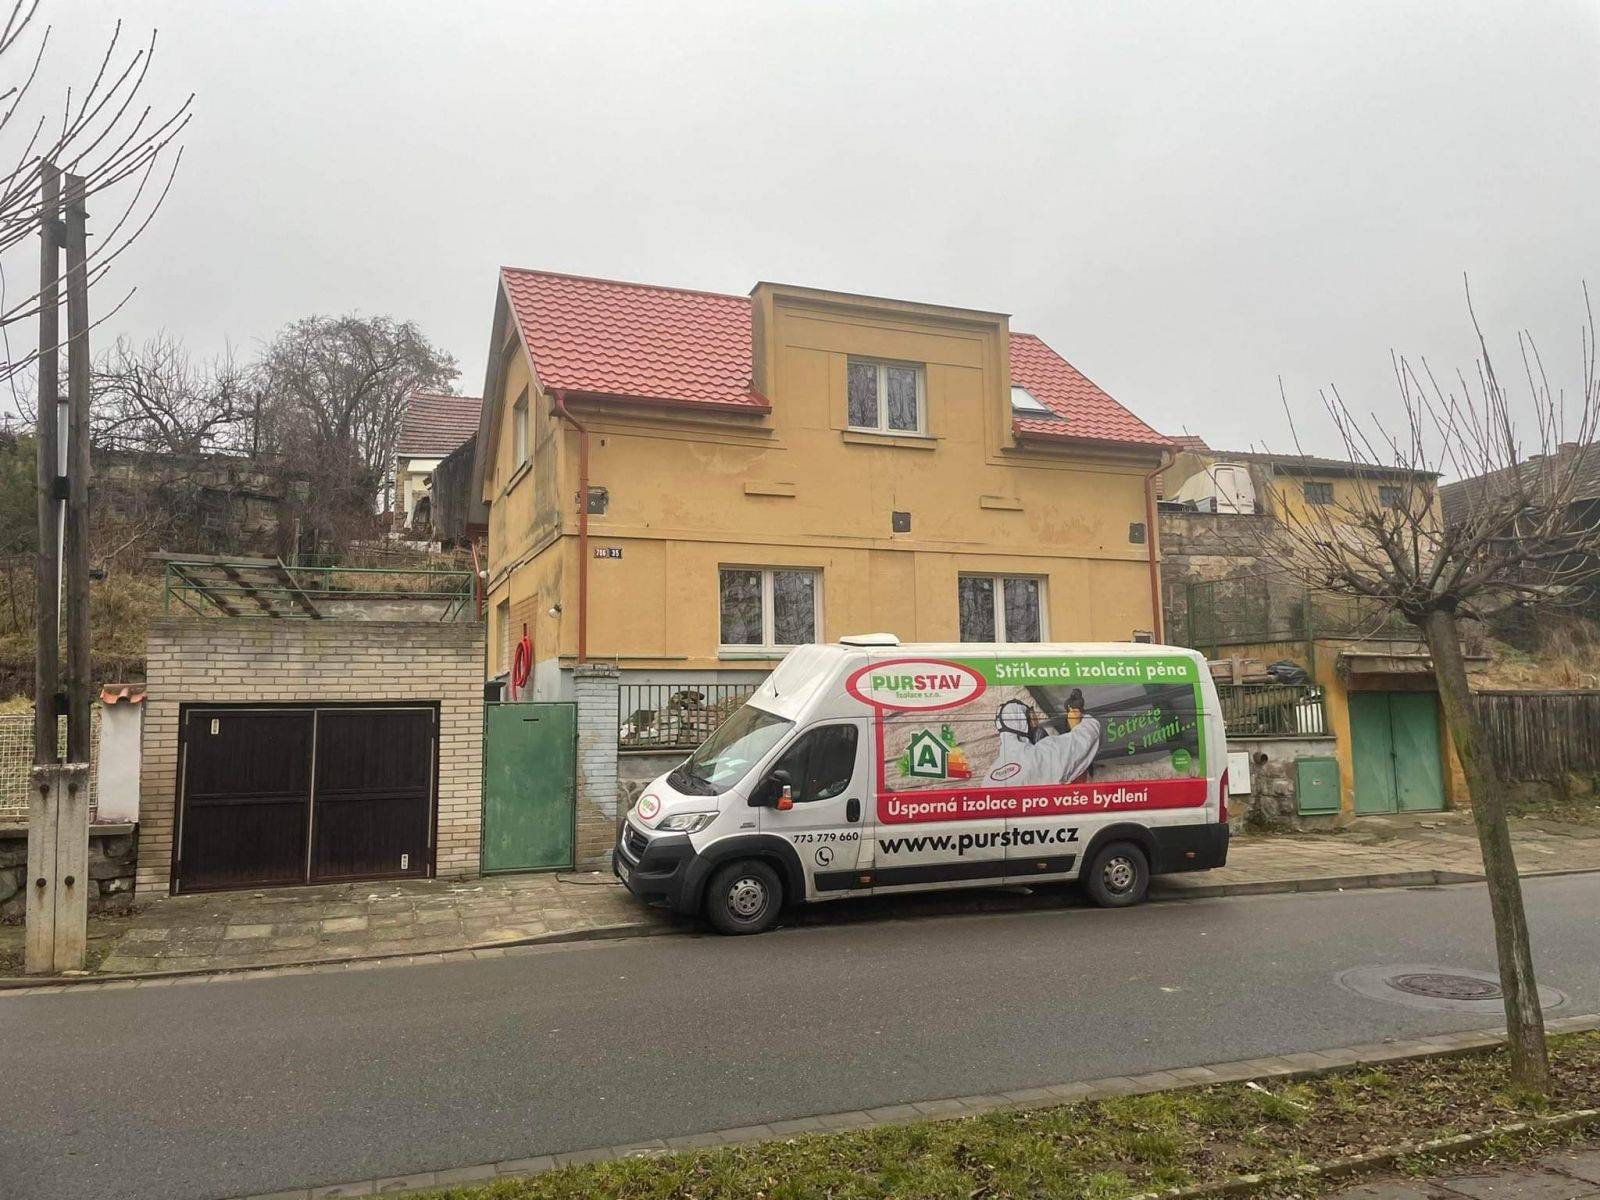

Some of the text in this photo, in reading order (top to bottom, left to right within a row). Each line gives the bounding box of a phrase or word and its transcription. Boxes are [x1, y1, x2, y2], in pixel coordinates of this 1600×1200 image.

[995, 659, 1187, 680] Stříkaná izolační pěna
[872, 674, 961, 691] PURSTAV
[917, 744, 938, 768] A
[1127, 741, 1136, 756] s
[888, 788, 1148, 819] Úsporná izolace pro vaše bydlení
[793, 832, 859, 844] 773 779 660
[878, 827, 1079, 856] www.purstav.cz
